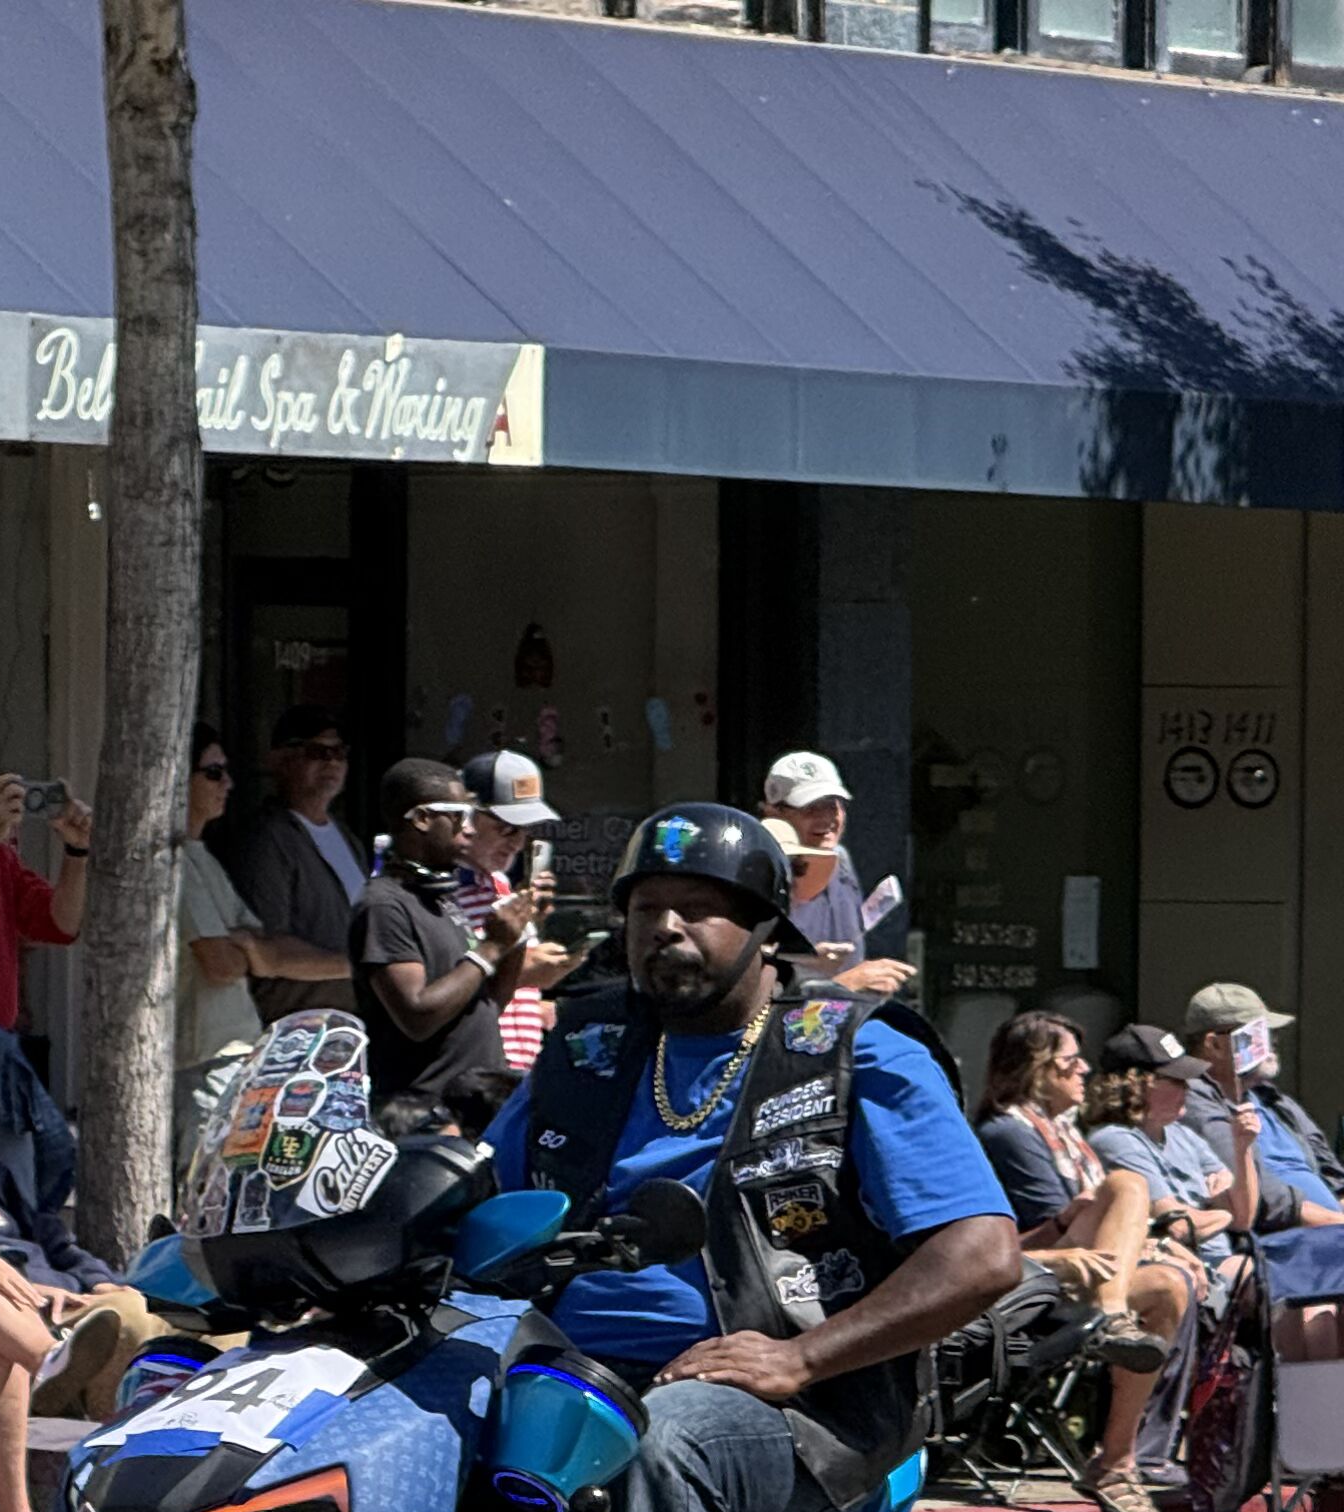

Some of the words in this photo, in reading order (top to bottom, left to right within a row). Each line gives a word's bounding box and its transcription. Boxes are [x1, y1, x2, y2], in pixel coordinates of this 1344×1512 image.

[37, 327, 117, 420] Bel
[195, 340, 248, 431] ail
[253, 352, 319, 449] Spa
[328, 349, 362, 435] &
[363, 356, 487, 460] Waxing
[274, 640, 312, 671] 1409
[1158, 709, 1213, 746] 1413
[1223, 711, 1278, 745] 1411
[313, 1131, 369, 1214] Cali
[158, 1368, 288, 1415] 94
